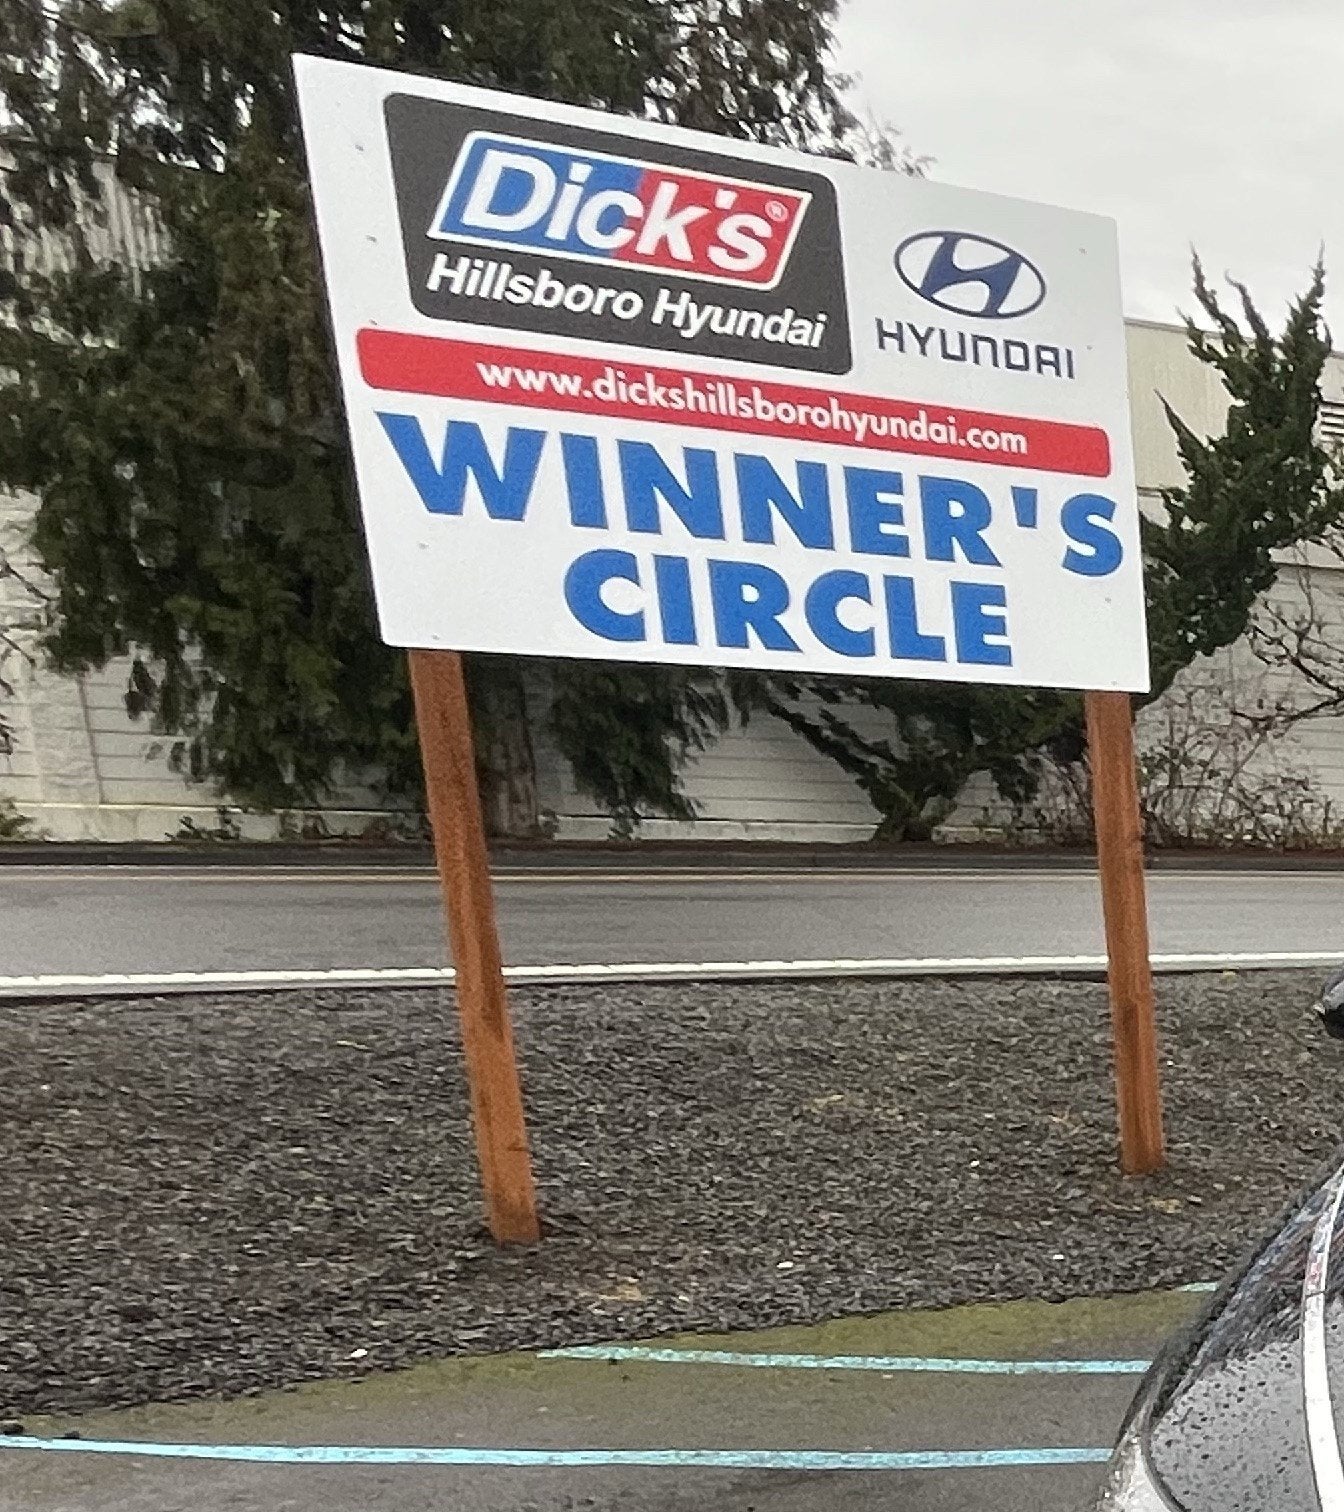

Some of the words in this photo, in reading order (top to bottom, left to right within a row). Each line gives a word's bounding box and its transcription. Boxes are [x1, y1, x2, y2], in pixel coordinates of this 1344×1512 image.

[460, 149, 773, 272] Dick's
[427, 254, 643, 320] Hillsboro
[651, 288, 827, 348] Hyundai
[875, 317, 1075, 379] HYUNDAI
[476, 359, 1029, 455] www.dickshillsborohyundai.com
[376, 411, 1124, 577] WINNER'S
[564, 548, 1013, 667] CIRCLE
